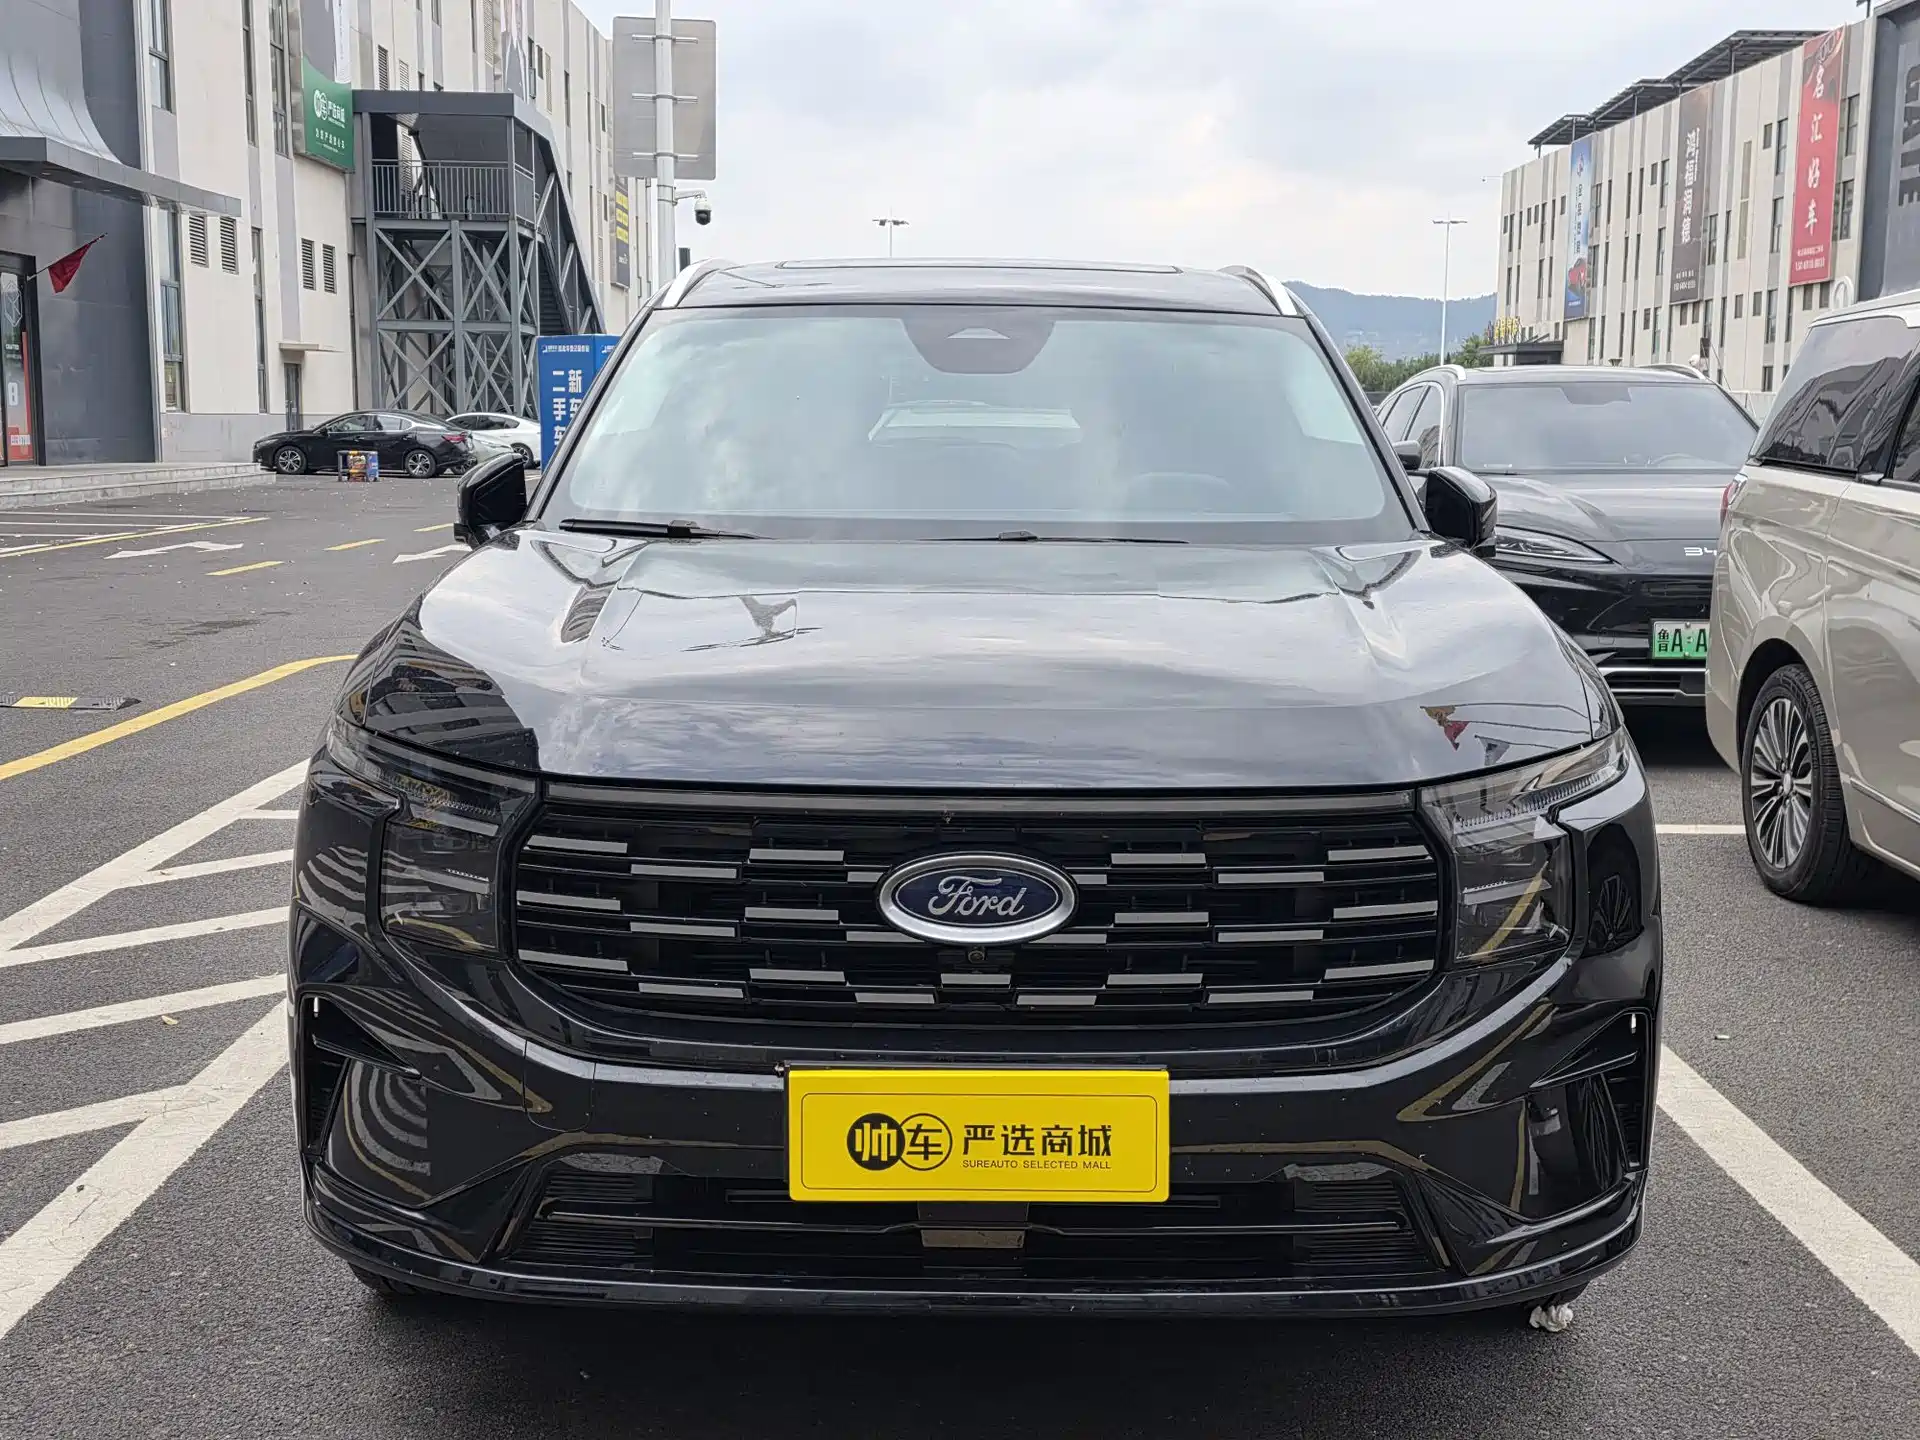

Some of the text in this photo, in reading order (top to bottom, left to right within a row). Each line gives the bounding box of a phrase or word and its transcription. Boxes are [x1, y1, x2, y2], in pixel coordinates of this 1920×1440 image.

[928, 875, 1027, 916] Ford
[853, 1120, 1112, 1163] 帅车 严选商城
[962, 1159, 1111, 1170] SUREAUTO SELECTED MALL
